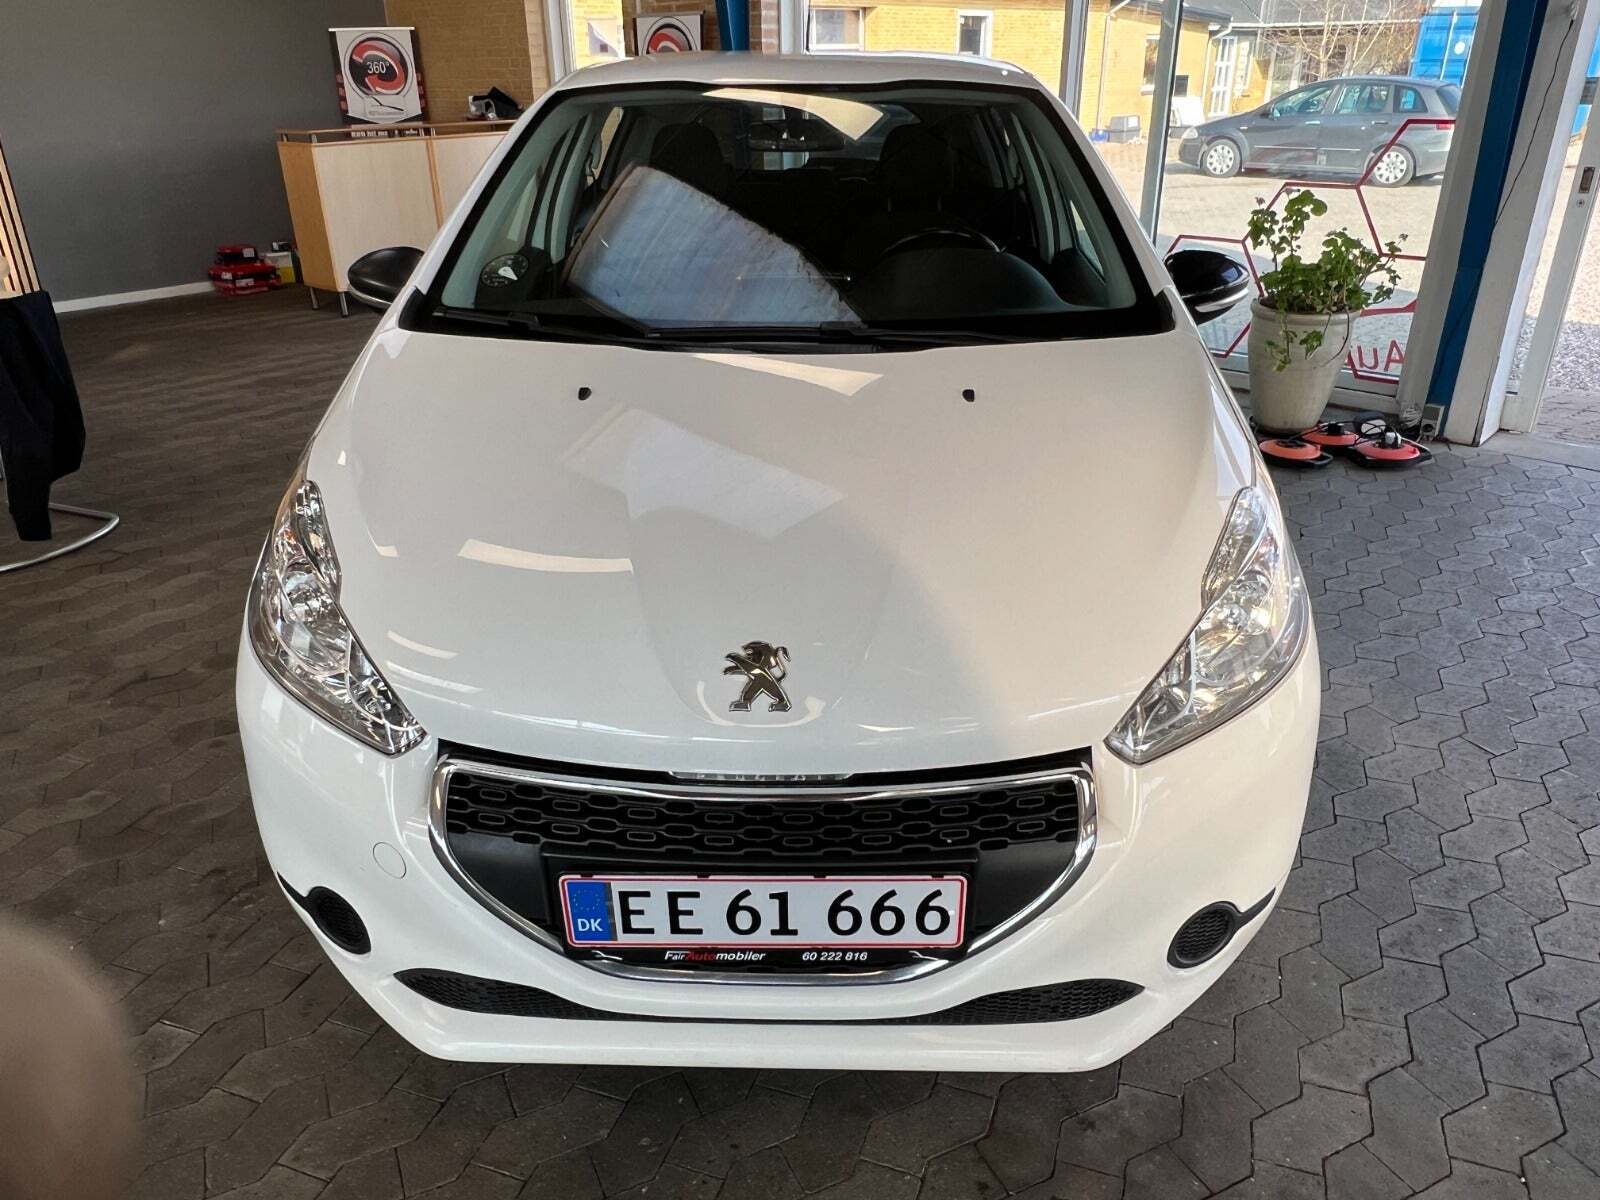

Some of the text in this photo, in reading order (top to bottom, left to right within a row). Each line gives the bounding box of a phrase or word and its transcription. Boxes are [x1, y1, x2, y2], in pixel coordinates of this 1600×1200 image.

[617, 888, 951, 937] EE 61 666
[577, 918, 604, 932] DK
[802, 951, 818, 961] 60
[820, 951, 842, 961] 222
